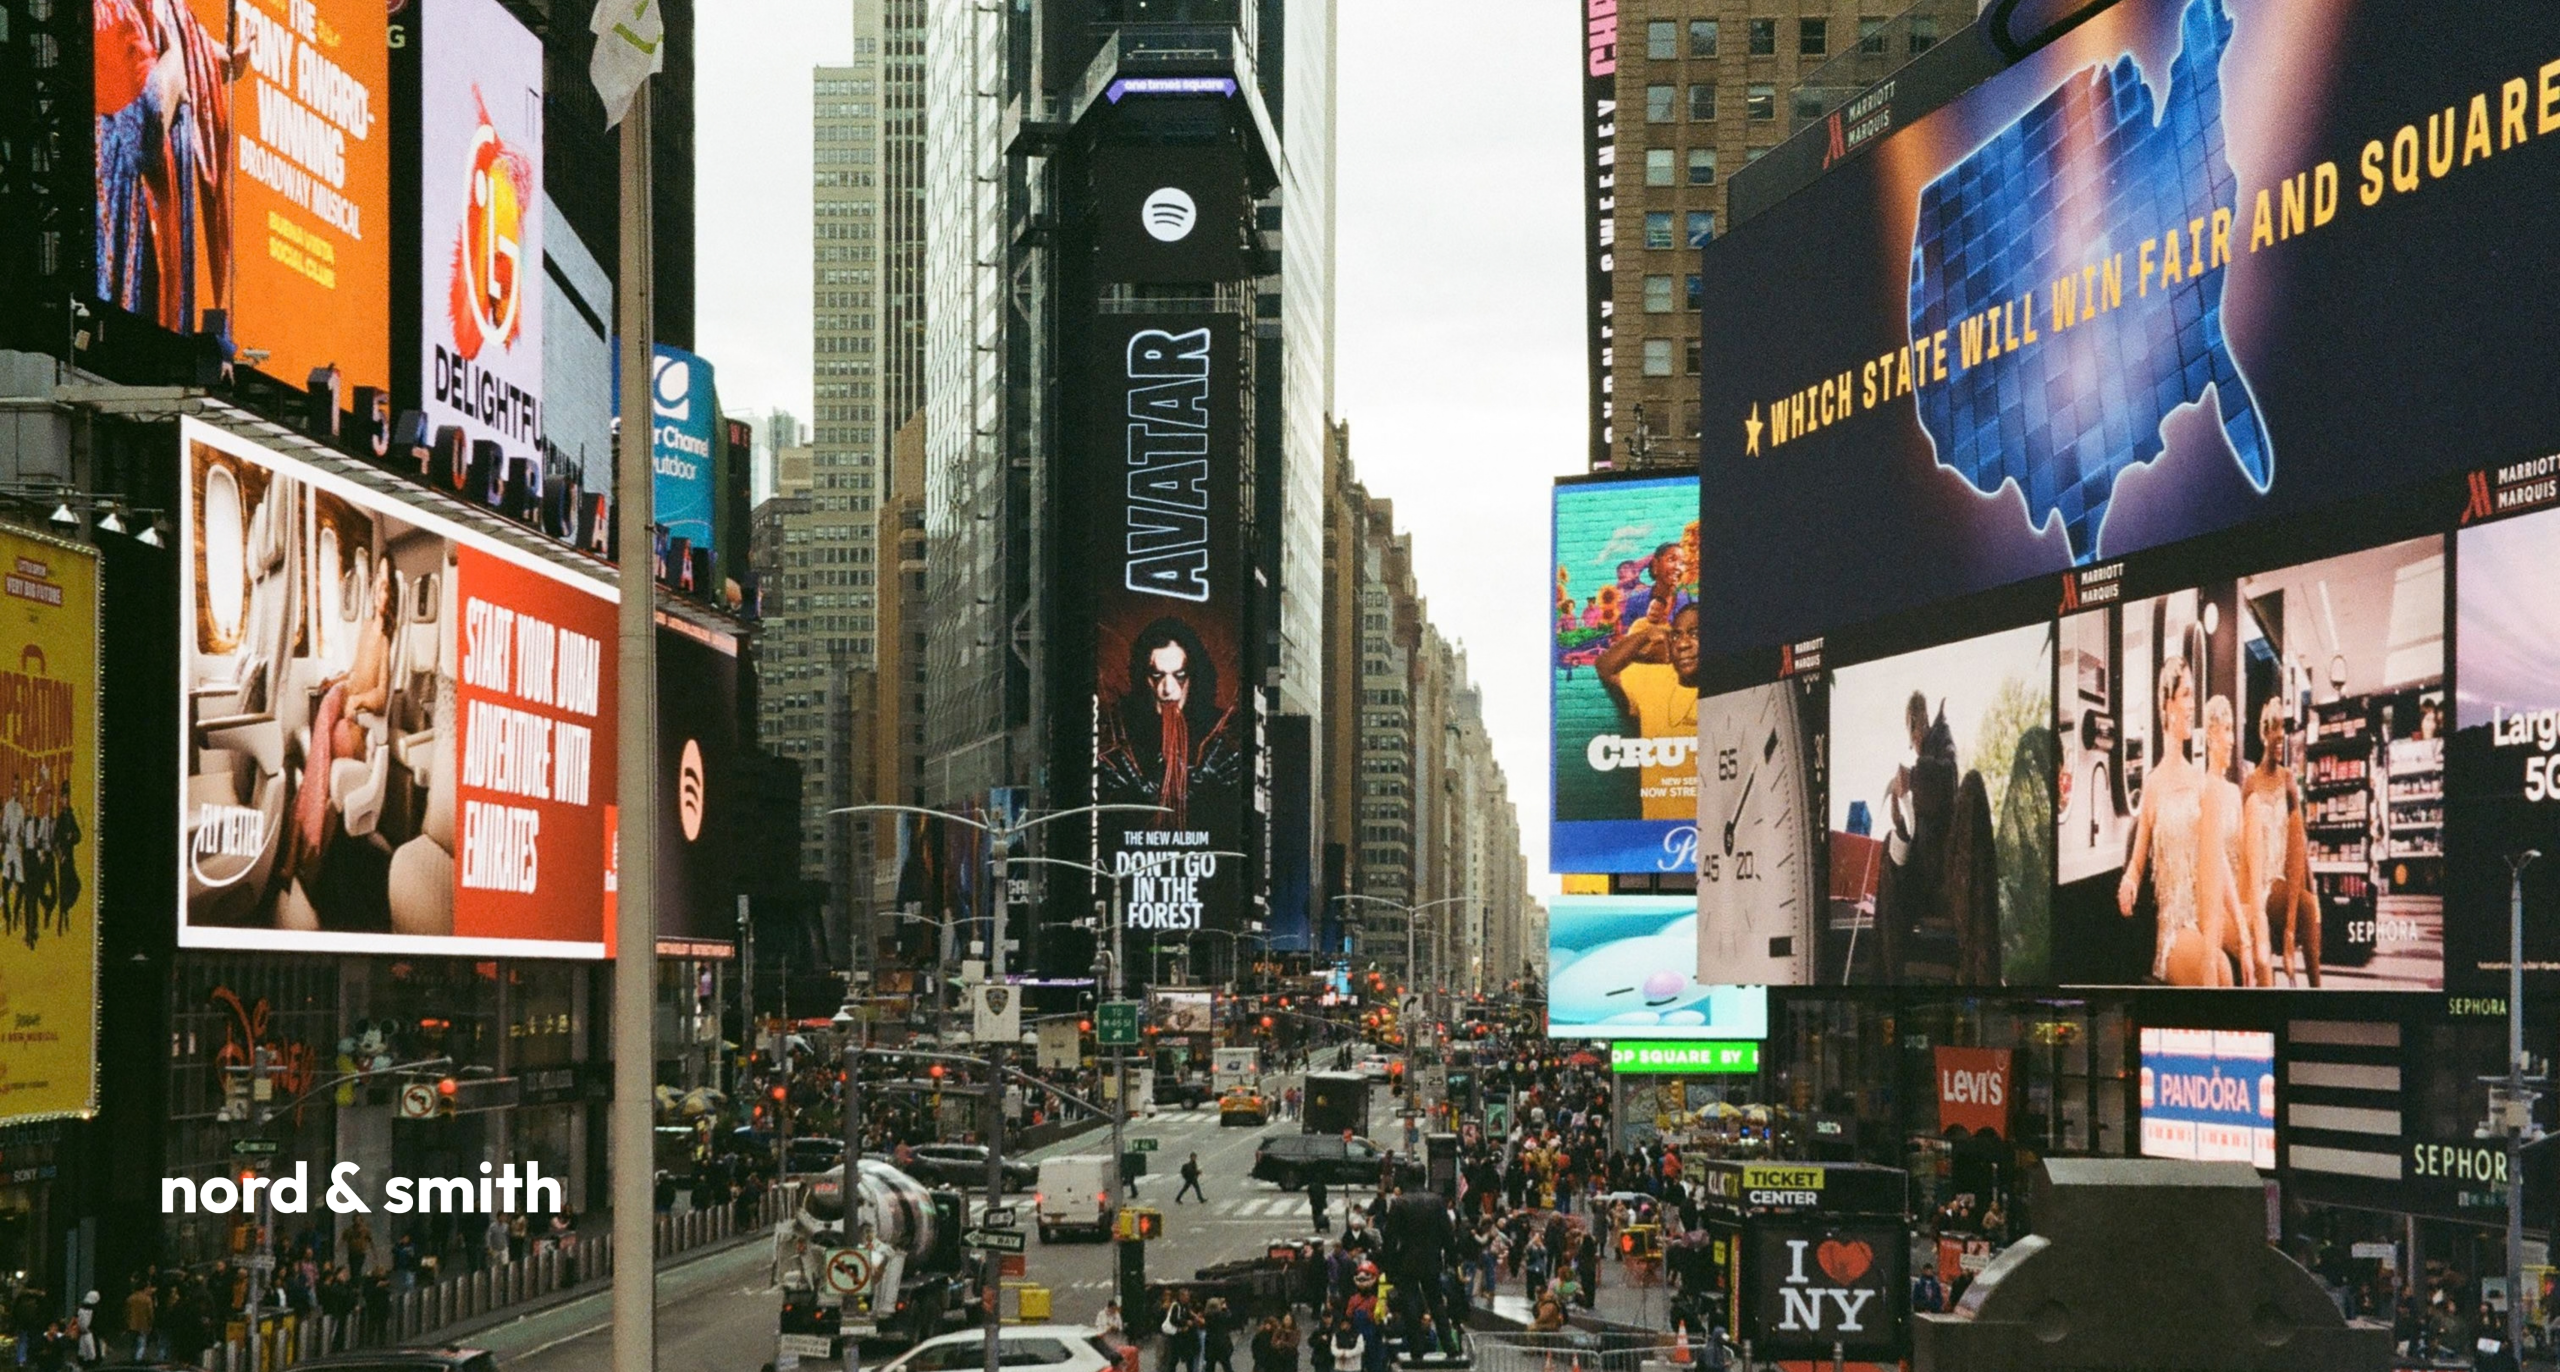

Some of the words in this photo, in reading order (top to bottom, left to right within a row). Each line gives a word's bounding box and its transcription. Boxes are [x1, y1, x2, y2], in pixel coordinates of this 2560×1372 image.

[290, 0, 316, 43] THE
[298, 41, 375, 140] AWARD-
[1124, 81, 1146, 90] one
[1148, 80, 1180, 90] times
[1183, 81, 1224, 92] square
[1849, 81, 1895, 122] MARRIOTT
[257, 77, 345, 190] WINNING
[1848, 109, 1889, 147] MARQUIS
[239, 134, 312, 210] BROADWAY
[312, 180, 362, 240] MUSICAL
[1770, 371, 1852, 448] WHICH
[1862, 328, 1947, 411] STATE
[1959, 291, 2038, 371] WILL
[2051, 252, 2122, 333] WIN
[2138, 206, 2232, 298] FAIR
[2250, 161, 2339, 253] AND
[2359, 58, 2560, 207] SQUARE
[663, 426, 710, 459] Channel
[653, 454, 697, 481] utdoor
[1125, 327, 1211, 602] AVATAR
[2498, 480, 2557, 508] MARQUIS
[2081, 563, 2124, 585] MARRIOTT
[2081, 583, 2119, 604] MARQUIS
[463, 596, 515, 693] START
[515, 613, 555, 706] YOUR
[556, 628, 600, 717] DUBAI
[2493, 706, 2560, 751] Larg
[462, 699, 553, 800] ADVENTURE
[554, 720, 592, 807] WITH
[1719, 748, 1738, 781] 65
[1640, 787, 1667, 798] NOW
[199, 803, 222, 853] FLY
[1124, 830, 1143, 845] THE
[1146, 831, 1170, 845] NEW
[1172, 831, 1209, 845] ALBUM
[461, 800, 540, 894] EMIRATES
[1115, 851, 1180, 878] DON'T
[1184, 851, 1216, 878] GO
[1703, 854, 1719, 882] 45
[1736, 852, 1753, 880] 20
[1133, 877, 1155, 903] IN
[1160, 877, 1198, 903] THE
[1128, 902, 1204, 929] FOREST
[2348, 921, 2418, 943] SEPHORA
[2448, 998, 2507, 1016] SEPHORA
[1639, 1049, 1711, 1063] SQUARE
[1720, 1049, 1742, 1063] BY
[2161, 1068, 2251, 1113] PANDORA
[1751, 1171, 1818, 1187] TICKET
[2414, 1143, 2523, 1184] SEPHOR
[1750, 1190, 1818, 1205] CENTER
[970, 1233, 988, 1245] ONE
[997, 1234, 1016, 1247] WAY
[1785, 1240, 1809, 1283] I
[1778, 1287, 1876, 1331] NY
